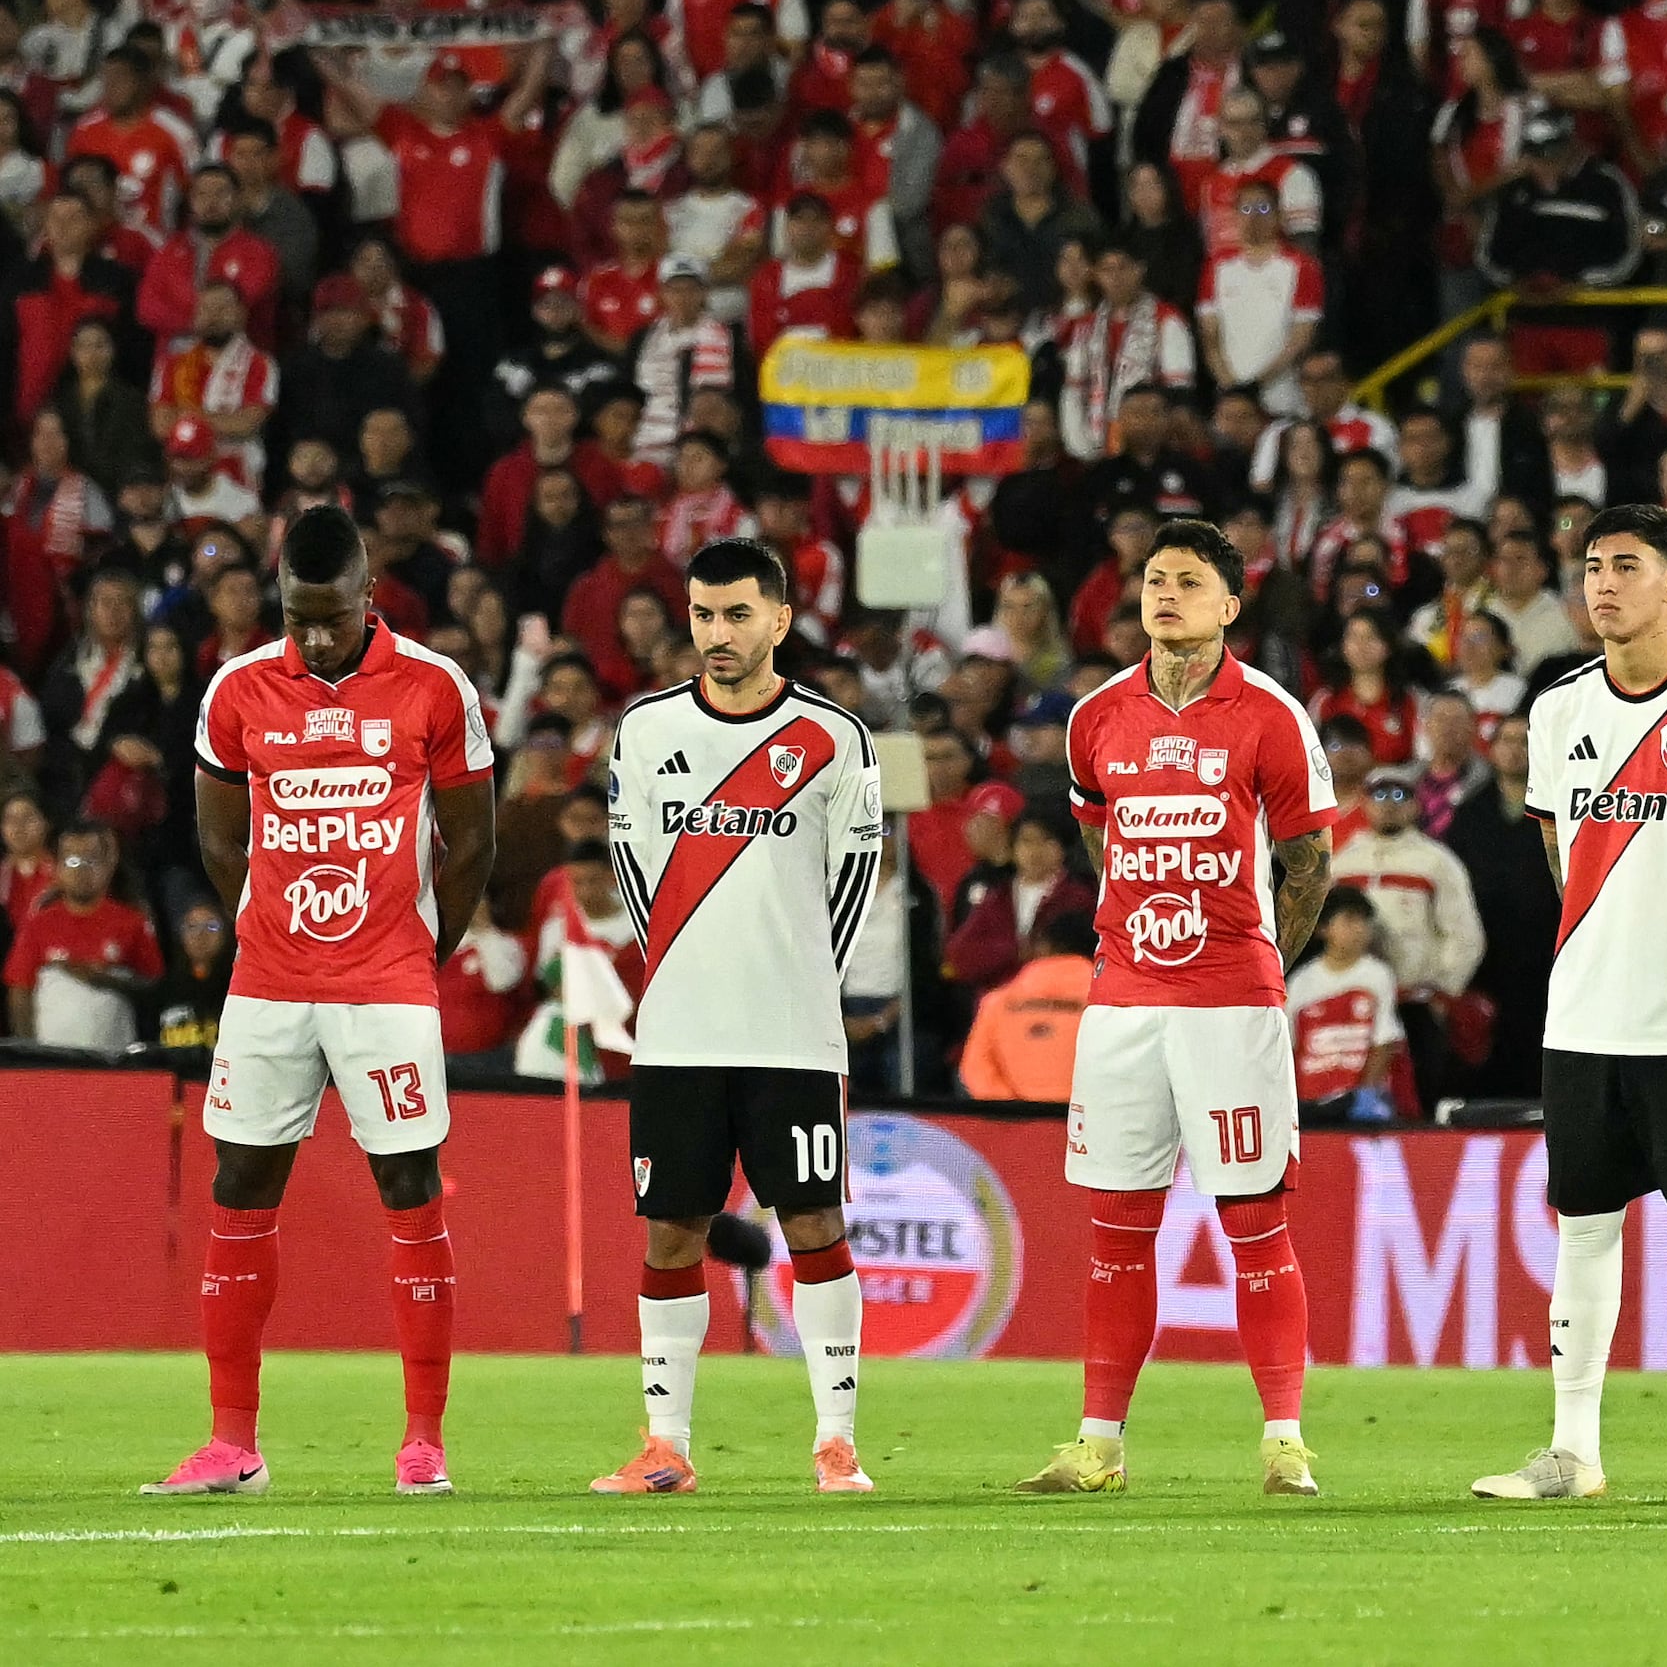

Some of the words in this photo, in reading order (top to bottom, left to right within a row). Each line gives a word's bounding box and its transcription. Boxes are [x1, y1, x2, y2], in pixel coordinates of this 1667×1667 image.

[264, 732, 297, 744] FILA
[309, 721, 350, 735] AGUILA
[1107, 762, 1139, 775] FILA
[1151, 749, 1191, 764] AGUILA
[273, 778, 387, 799] Colanta
[662, 801, 797, 837] Betano
[1116, 805, 1221, 828] Colanta
[262, 812, 405, 854] BetPlay
[1110, 842, 1242, 887] BetPlay
[284, 858, 370, 934] Pool
[1126, 889, 1208, 963] Pool
[209, 1096, 232, 1110] FILA
[367, 1062, 428, 1122] 13
[1208, 1105, 1262, 1165] 10
[791, 1124, 837, 1182] 10
[825, 1345, 856, 1358] RIVER
